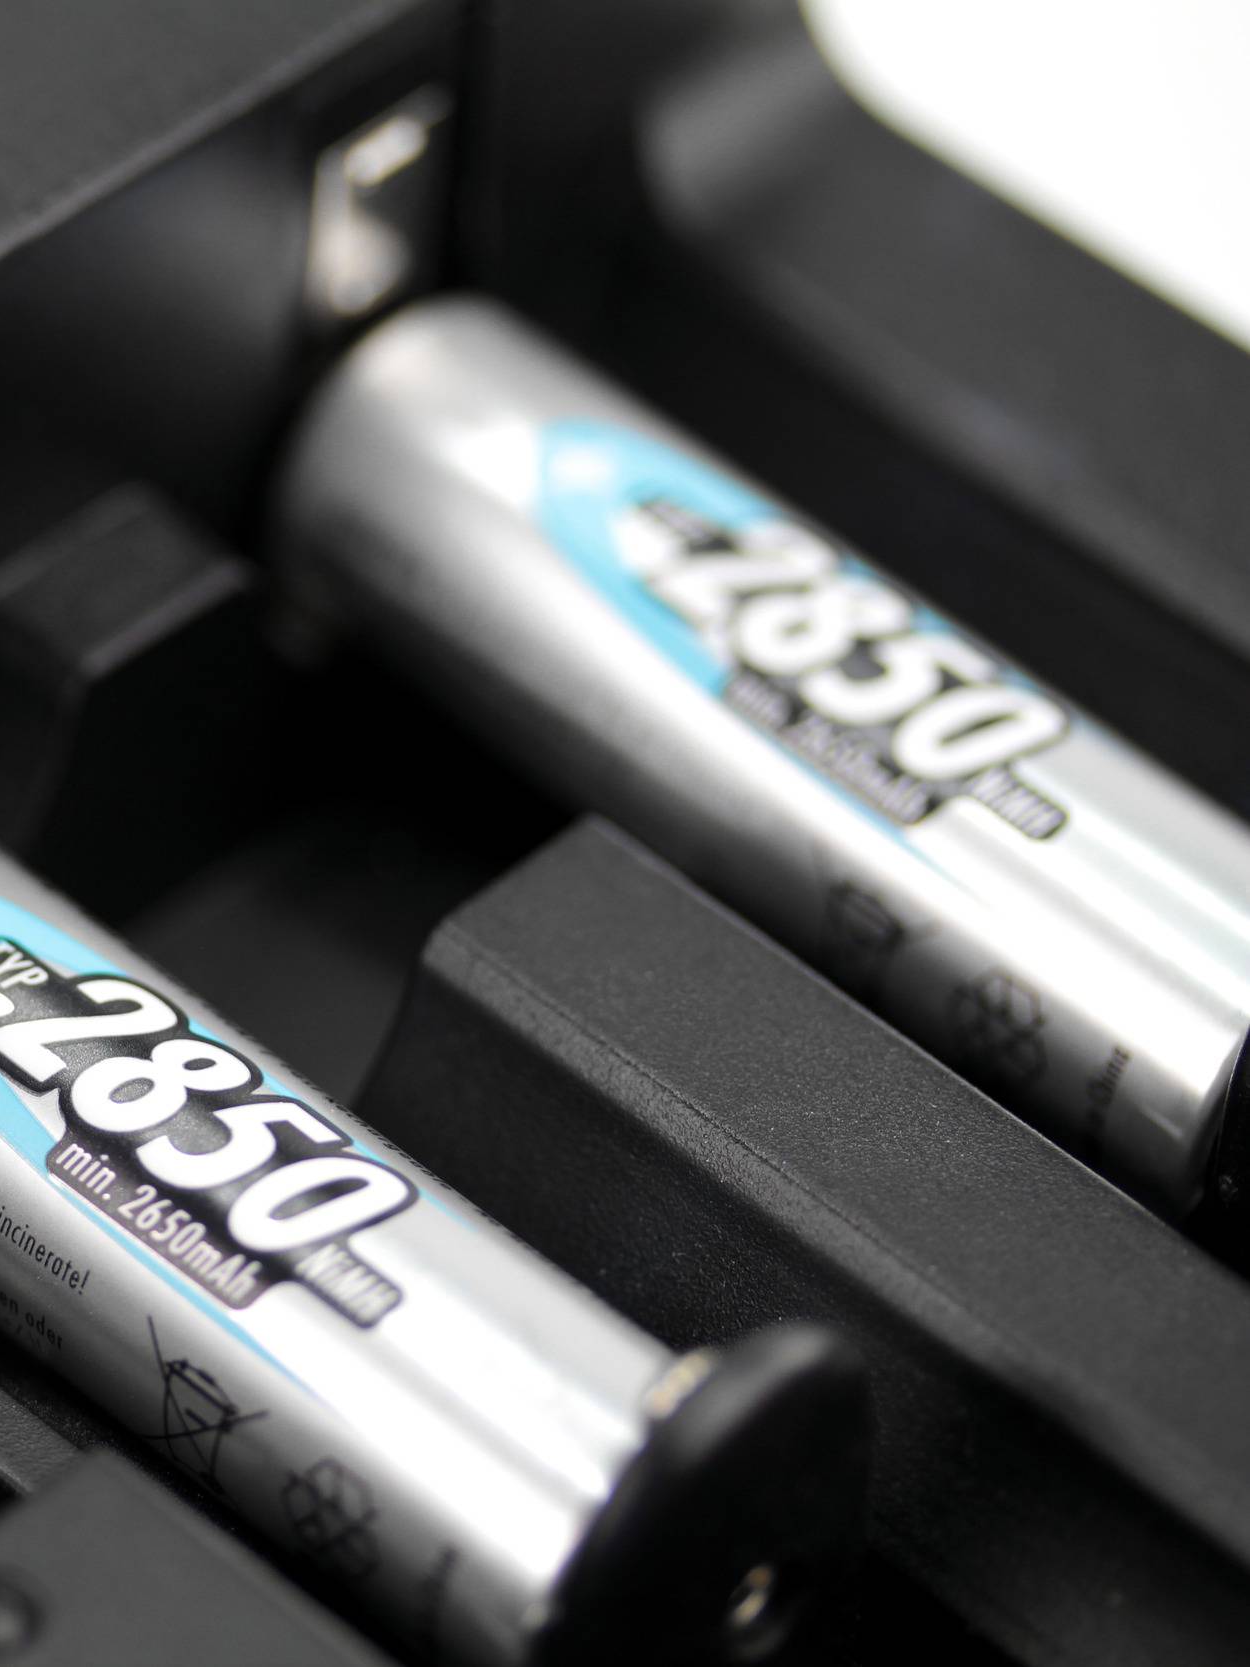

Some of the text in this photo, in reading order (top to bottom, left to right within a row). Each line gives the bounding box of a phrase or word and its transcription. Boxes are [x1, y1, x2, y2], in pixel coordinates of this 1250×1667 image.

[655, 522, 1069, 779] 2850
[56, 1142, 264, 1300] min. 2650mAh
[25, 1315, 64, 1350] oder
